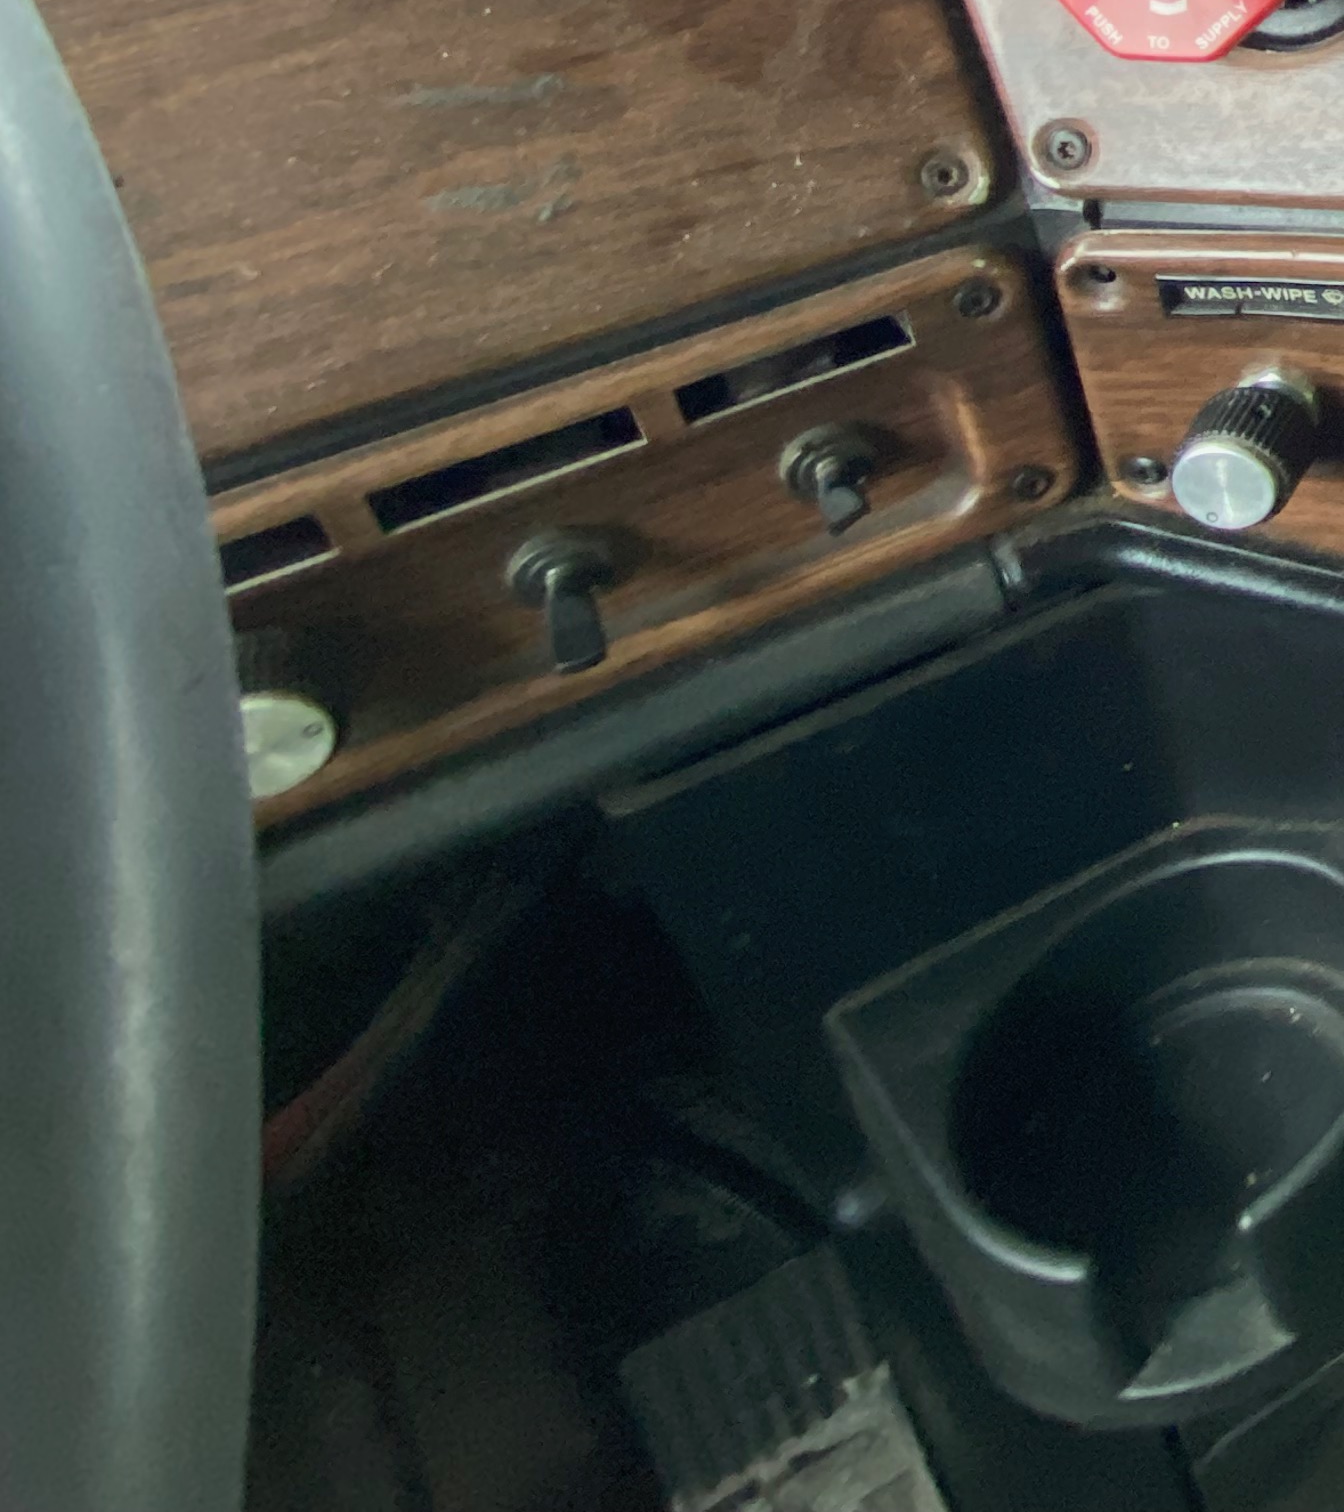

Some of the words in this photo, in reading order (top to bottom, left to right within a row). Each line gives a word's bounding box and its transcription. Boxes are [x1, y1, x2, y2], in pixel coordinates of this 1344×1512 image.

[1085, 6, 1123, 46] PUSH
[1148, 36, 1170, 49] TO
[1195, 0, 1249, 50] SUPPLY
[1184, 286, 1318, 304] WASH-WIPE
